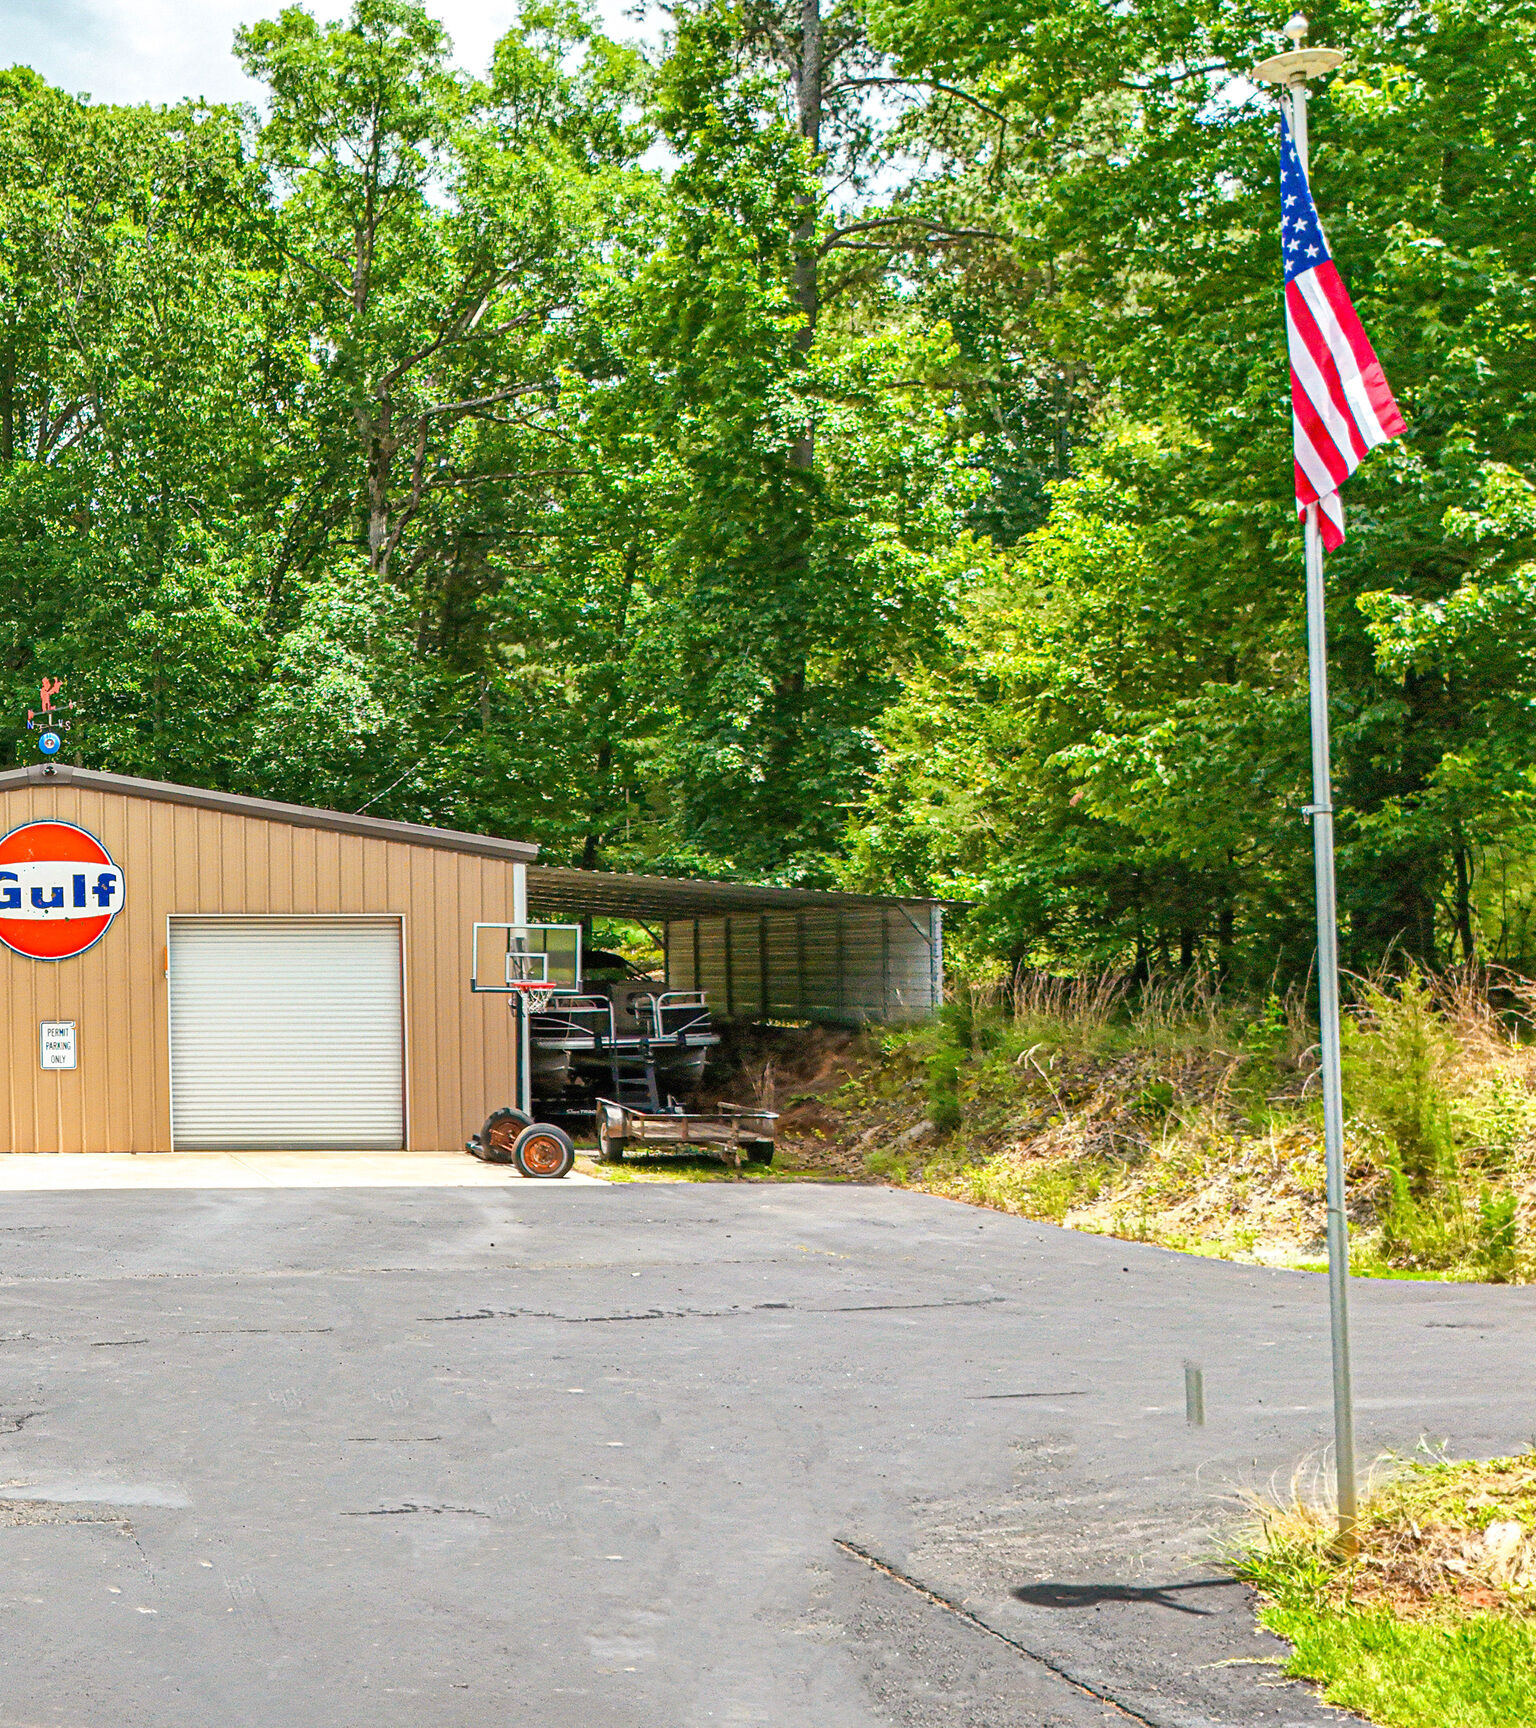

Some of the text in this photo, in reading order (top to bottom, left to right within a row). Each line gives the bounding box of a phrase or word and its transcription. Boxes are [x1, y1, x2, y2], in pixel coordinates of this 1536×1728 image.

[47, 1028, 69, 1037] PERMIT
[45, 1041, 71, 1050] PARKING
[50, 1054, 66, 1064] ONLY
